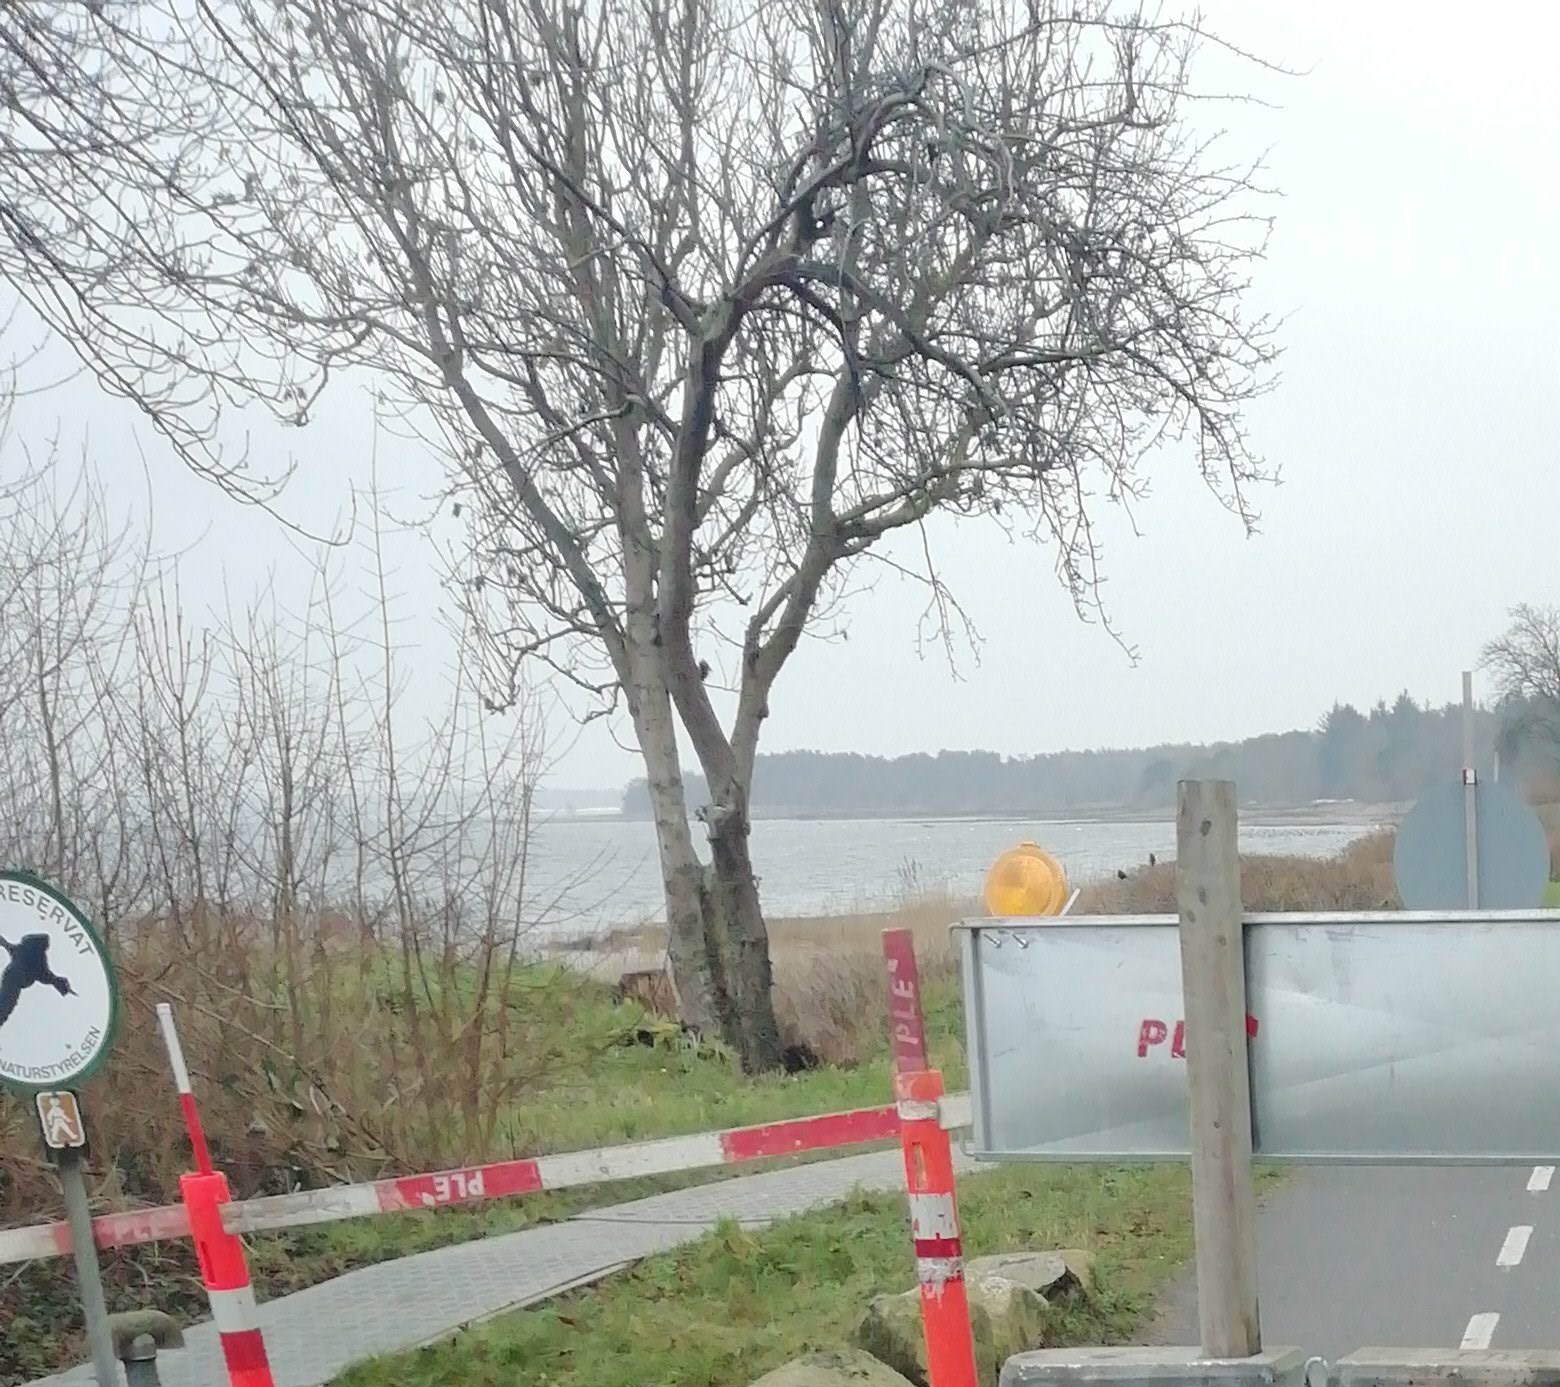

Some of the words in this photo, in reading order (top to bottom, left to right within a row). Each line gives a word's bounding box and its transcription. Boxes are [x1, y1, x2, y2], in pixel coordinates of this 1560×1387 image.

[893, 978, 919, 1045] PLE
[1137, 1019, 1187, 1058] PL
[432, 1170, 485, 1202] PLE
